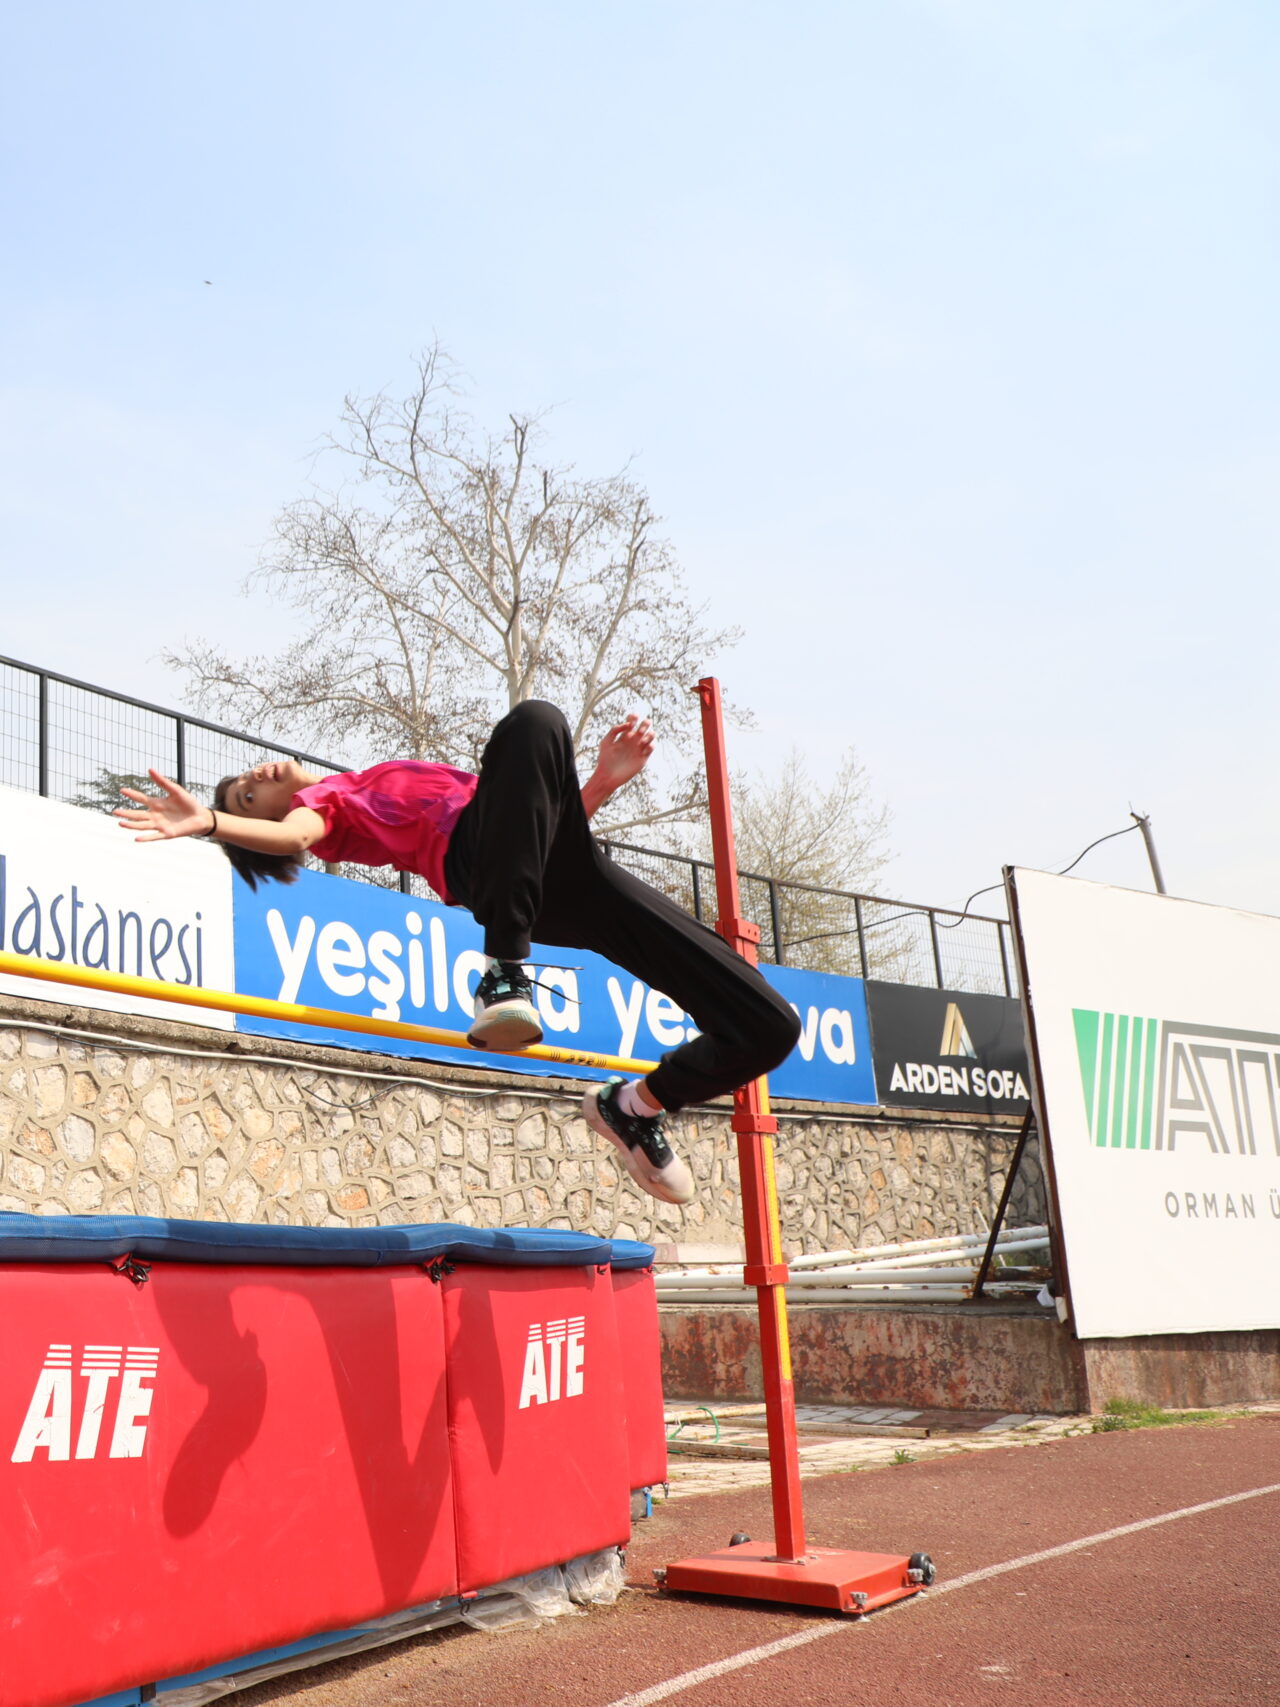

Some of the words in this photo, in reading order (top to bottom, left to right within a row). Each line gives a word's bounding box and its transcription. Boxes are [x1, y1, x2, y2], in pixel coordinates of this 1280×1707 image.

[889, 1062, 970, 1096] ARDEN
[971, 1066, 1031, 1101] SOFA
[1164, 1190, 1256, 1219] ORMAN
[518, 1315, 586, 1410] ATE
[10, 1342, 161, 1464] ATE
